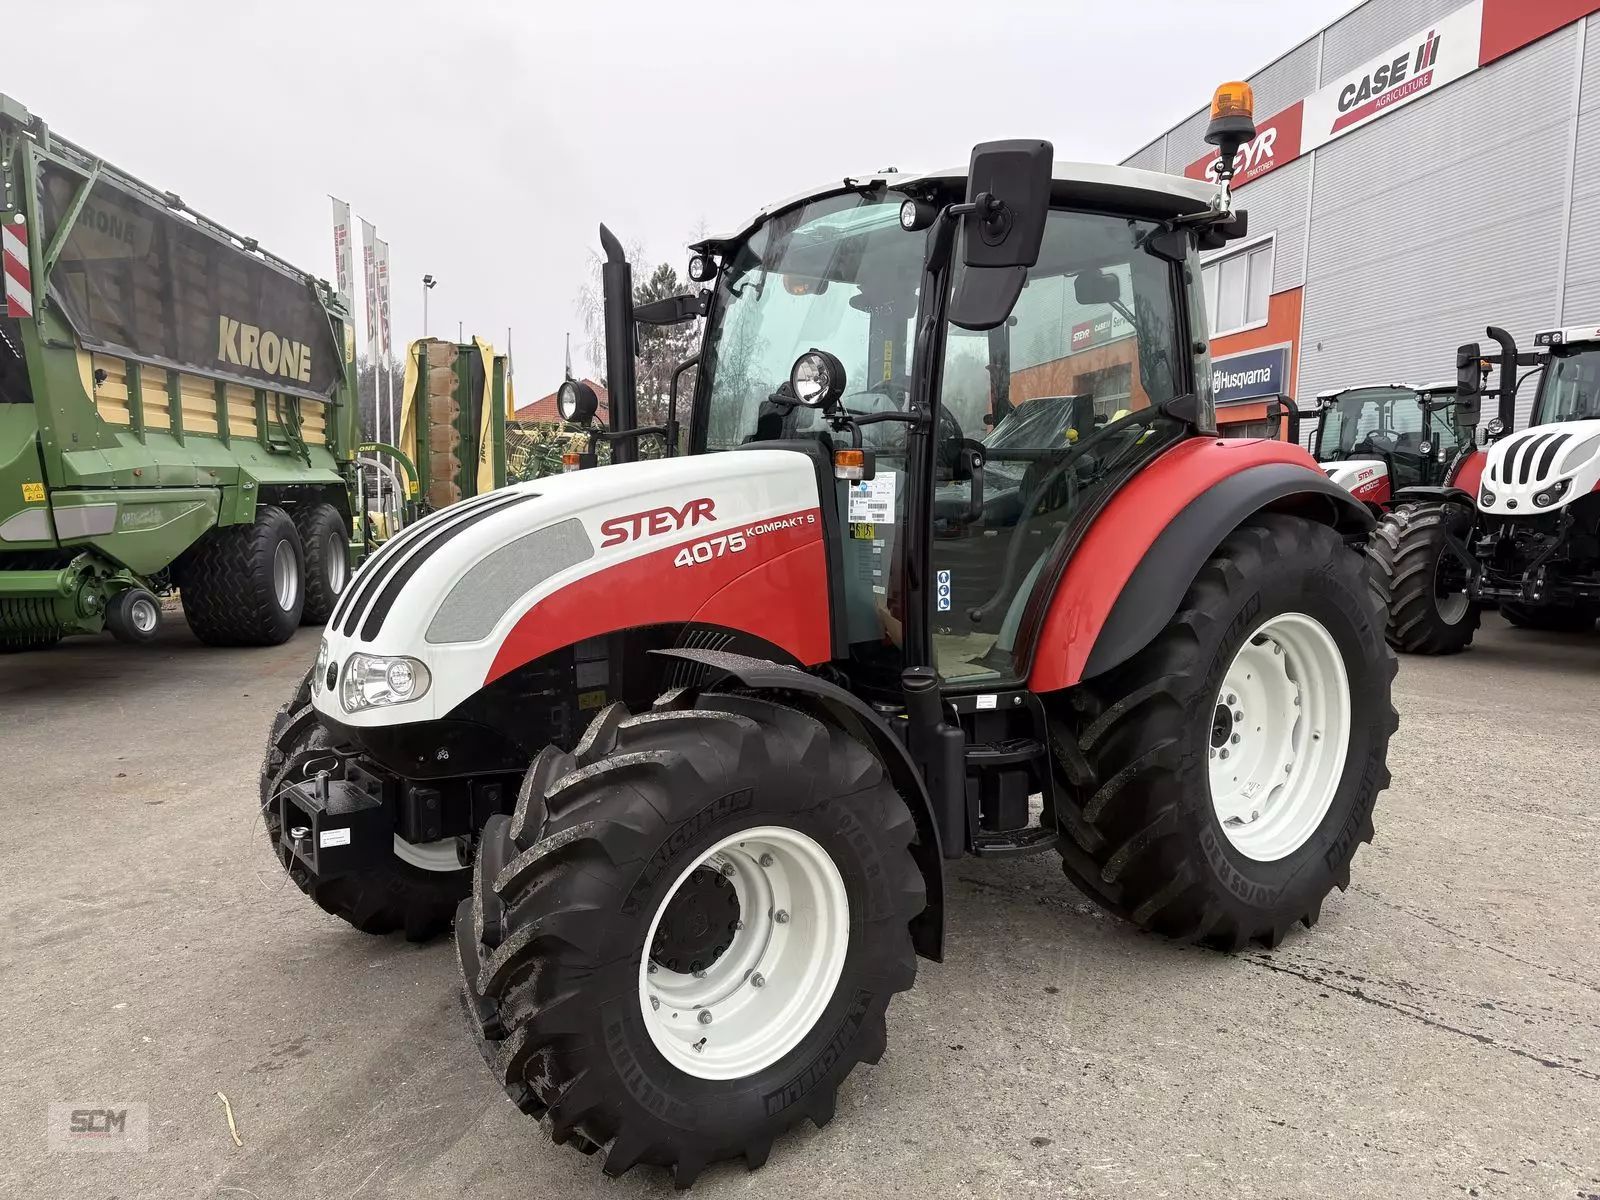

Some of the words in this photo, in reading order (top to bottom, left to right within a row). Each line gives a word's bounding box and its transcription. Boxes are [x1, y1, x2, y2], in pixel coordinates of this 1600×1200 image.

[1338, 52, 1410, 113] CASE
[1375, 74, 1429, 109] AGRICULTURE
[1204, 127, 1277, 185] SEYR
[218, 314, 311, 383] KRONE
[1073, 329, 1090, 343] STEYR
[1221, 367, 1271, 389] Husqvarna
[1358, 468, 1375, 482] STEYR
[601, 497, 717, 549] STEYR
[673, 532, 747, 568] 4075
[746, 516, 804, 538] KOMPAKT
[806, 514, 816, 524] S
